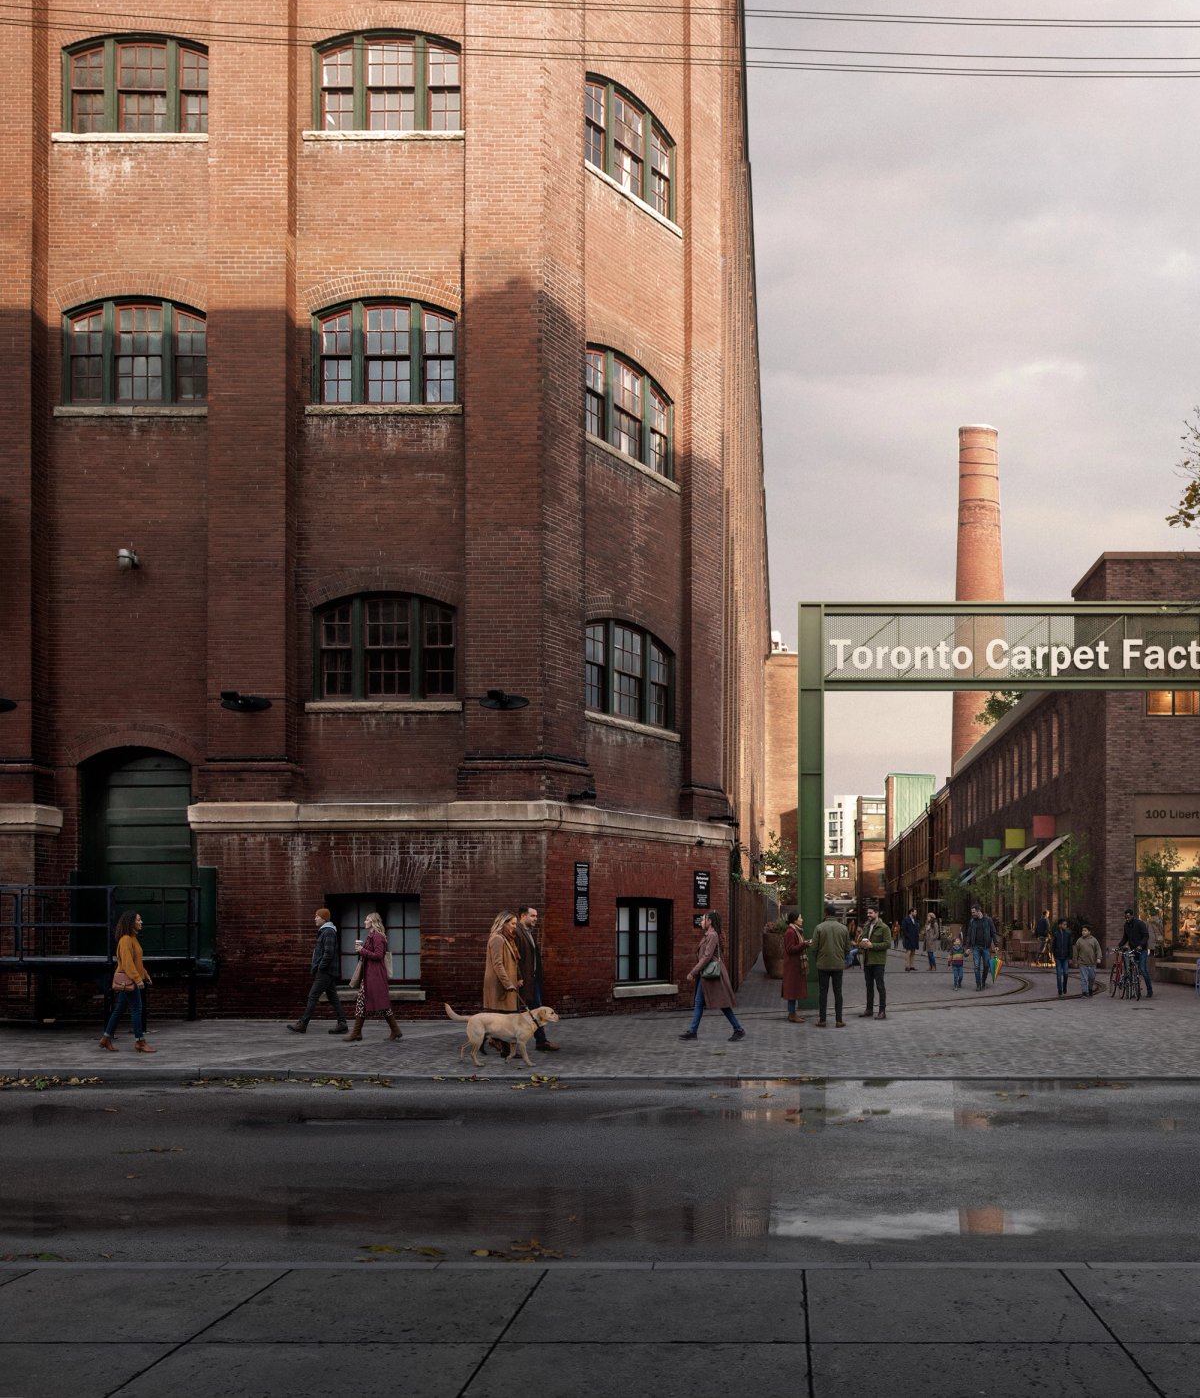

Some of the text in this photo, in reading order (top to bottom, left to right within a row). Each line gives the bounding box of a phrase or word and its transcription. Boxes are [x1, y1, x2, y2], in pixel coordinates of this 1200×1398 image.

[829, 638, 974, 670] Toronto
[985, 638, 1110, 677] Carpet
[1145, 809, 1167, 819] 100
